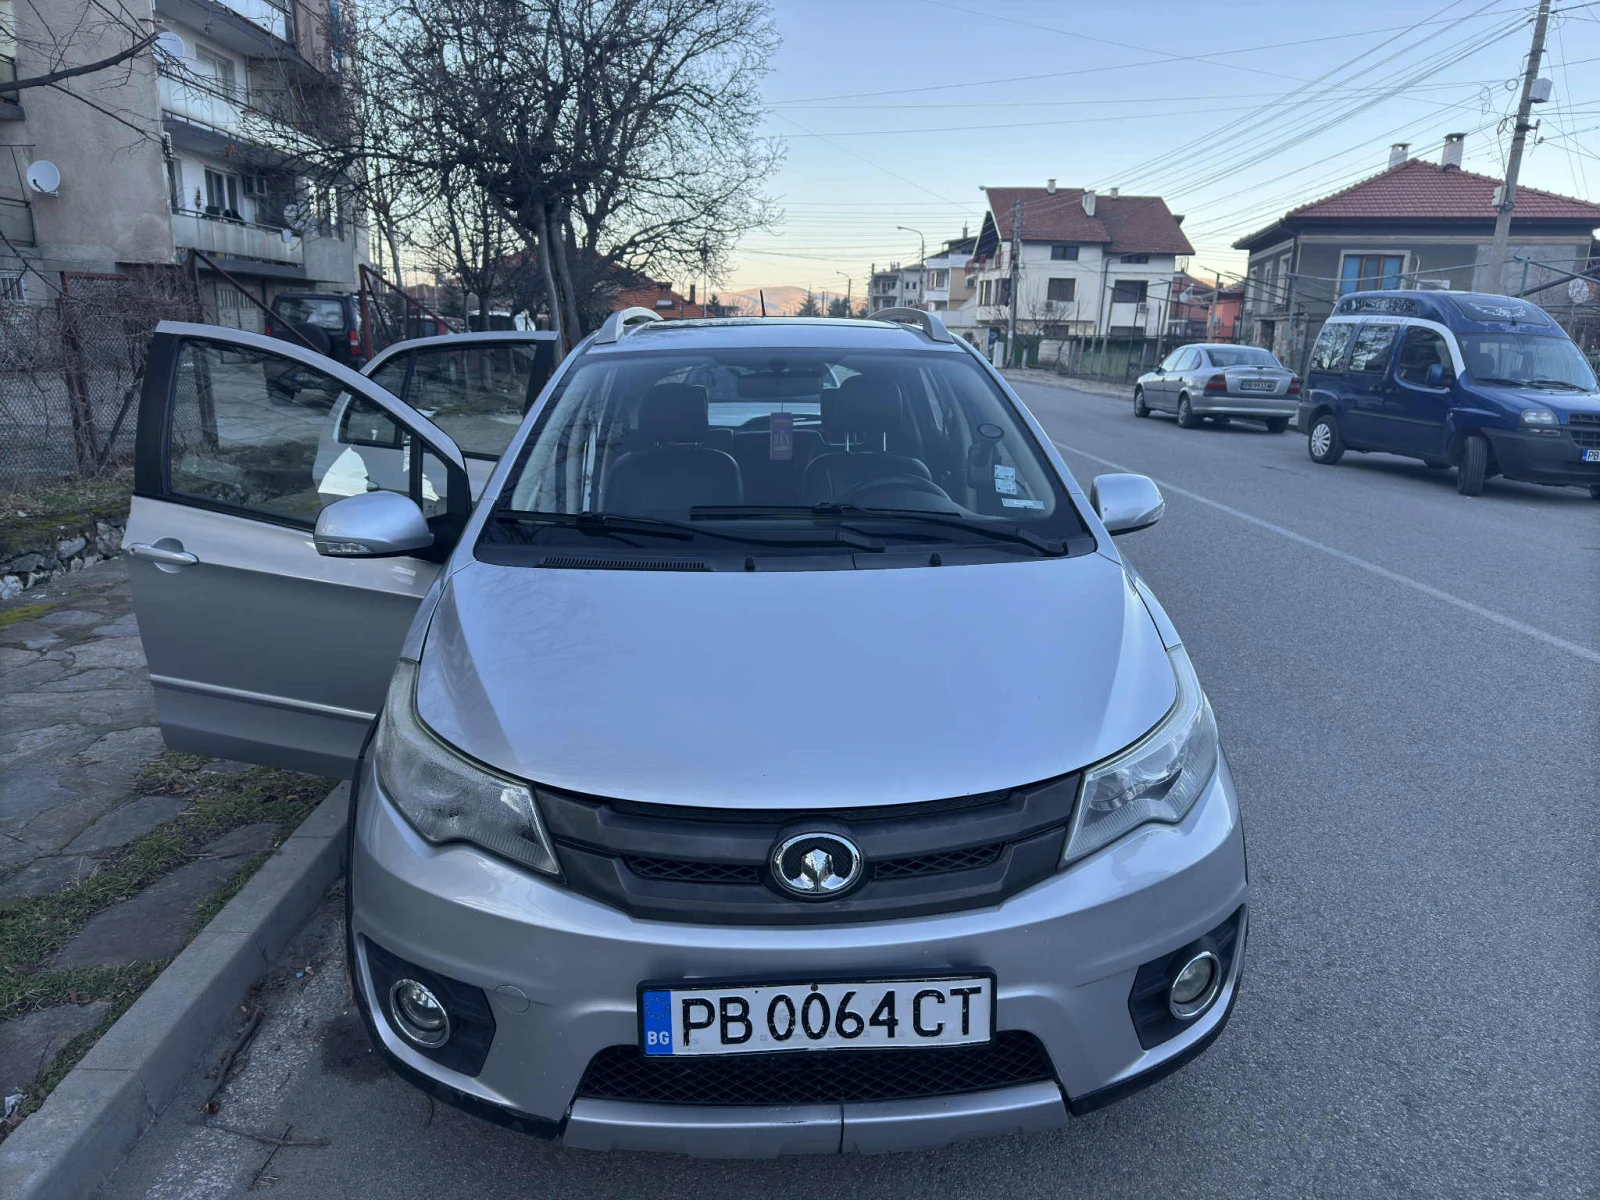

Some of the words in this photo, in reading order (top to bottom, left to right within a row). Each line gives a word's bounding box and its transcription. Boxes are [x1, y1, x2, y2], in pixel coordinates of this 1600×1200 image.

[1588, 450, 1599, 461] PB
[682, 995, 753, 1047] PB
[767, 990, 899, 1042] 0064
[912, 986, 982, 1038] CT
[647, 1030, 670, 1046] BG
